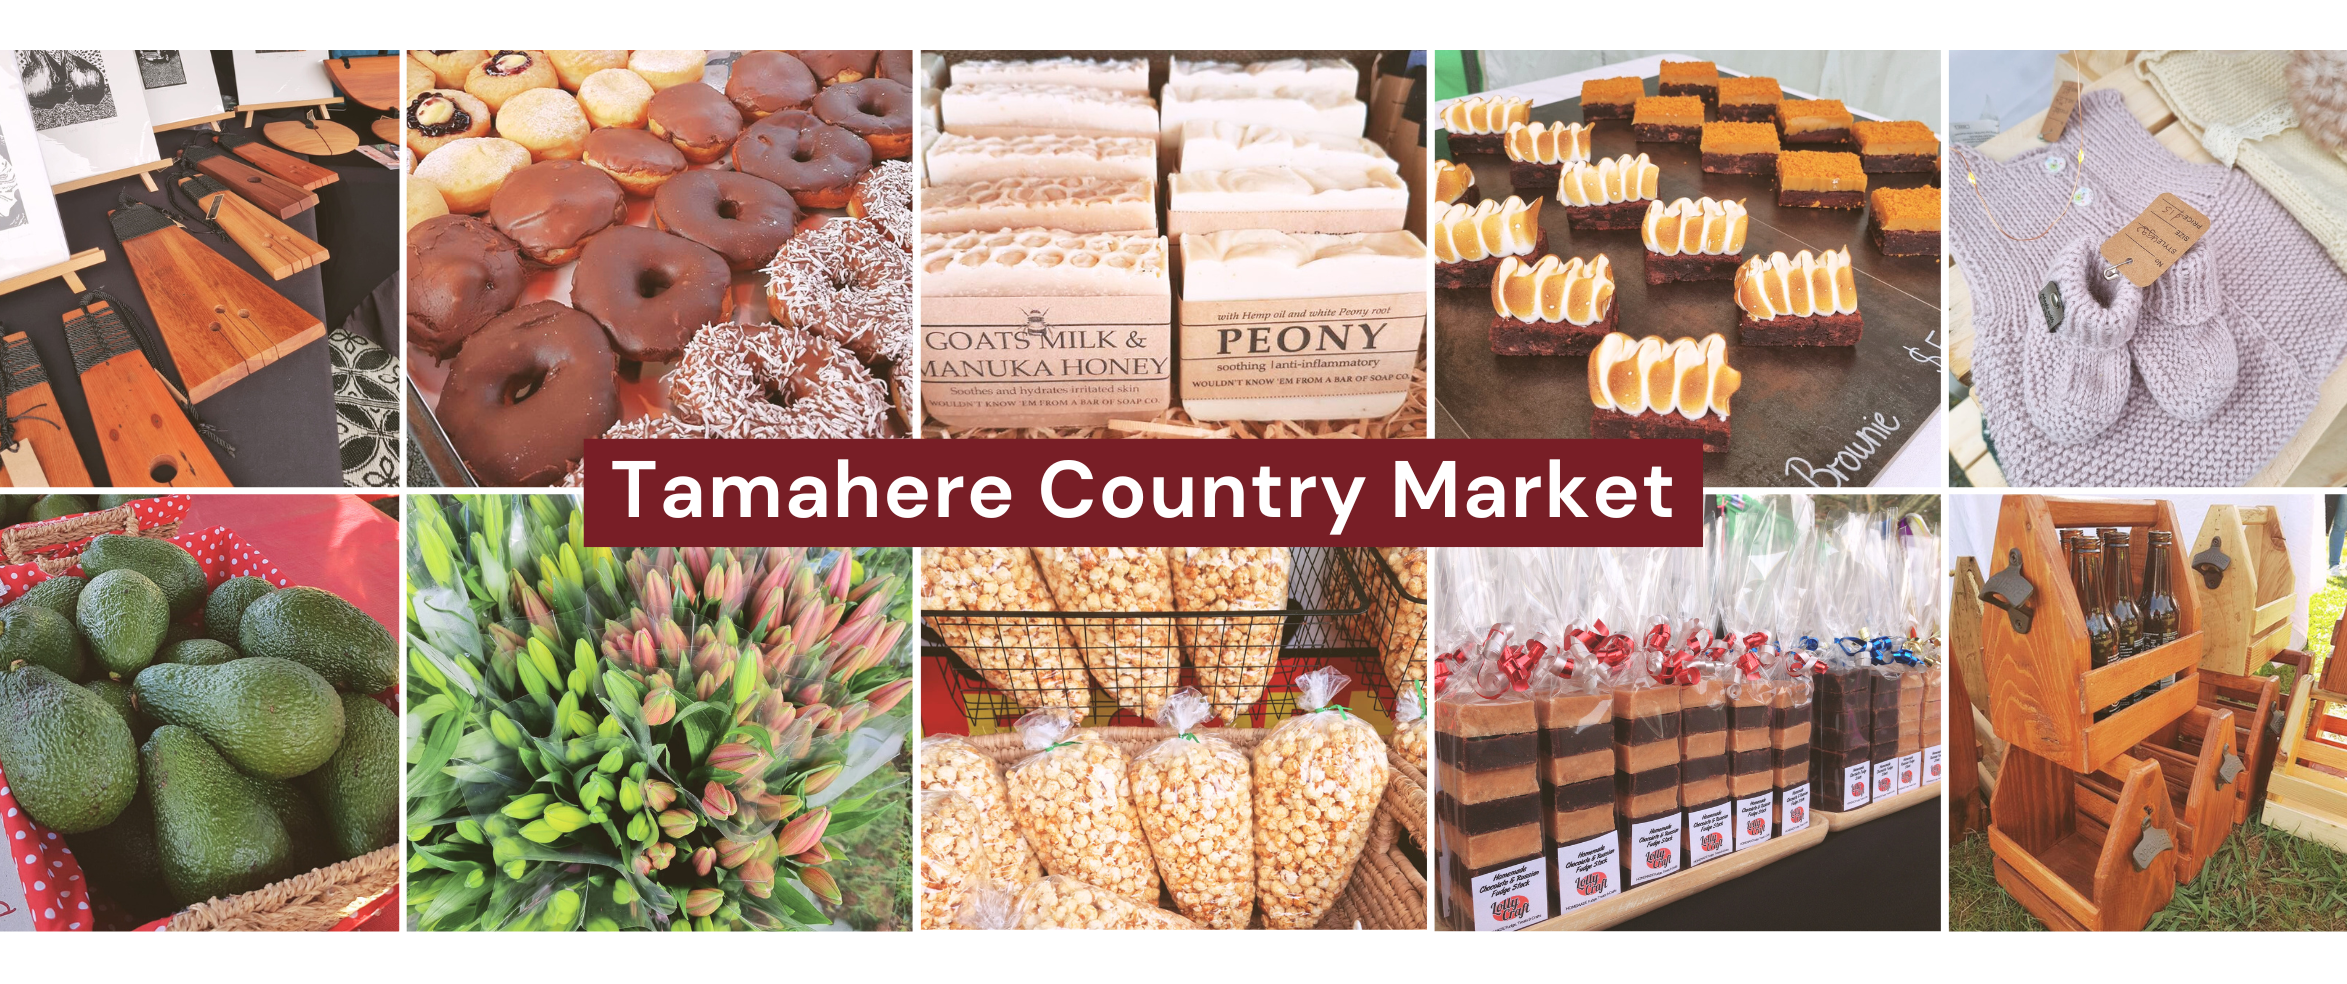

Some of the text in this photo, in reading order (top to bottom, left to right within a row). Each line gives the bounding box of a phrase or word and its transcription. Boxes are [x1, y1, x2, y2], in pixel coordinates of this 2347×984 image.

[2182, 214, 2203, 230] PRICE
[2174, 229, 2190, 242] SIZE
[2156, 239, 2177, 255] STYLE
[1217, 306, 1391, 321] with Hemp oil and white Peony root
[925, 330, 1147, 350] GOATS MILK &
[1216, 322, 1388, 355] PEONY
[921, 357, 1169, 378] MANUKA HONEY
[1216, 361, 1266, 372] soothing
[1192, 379, 1242, 388] WOULDN'T
[1245, 378, 1275, 386] KNOW
[1296, 376, 1323, 384] FROM
[1334, 375, 1353, 383] BAR
[1370, 374, 1394, 382] SOAP
[950, 384, 1140, 397] Soothes and hydrates irritated skin
[929, 399, 982, 408] WOULDN'T
[985, 399, 1016, 408] KNOW
[1040, 399, 1068, 407] FROM
[1080, 398, 1100, 406] BAR
[1117, 397, 1142, 405] SOAP
[1785, 412, 1901, 487] Brownie
[1492, 866, 1528, 882] Homemade
[1479, 880, 1509, 894] Chocolate
[1516, 871, 1540, 882] Russian
[1491, 880, 1531, 898] Fudge Stack
[1490, 898, 1519, 916] Lolly
[1502, 903, 1530, 921] Craft
